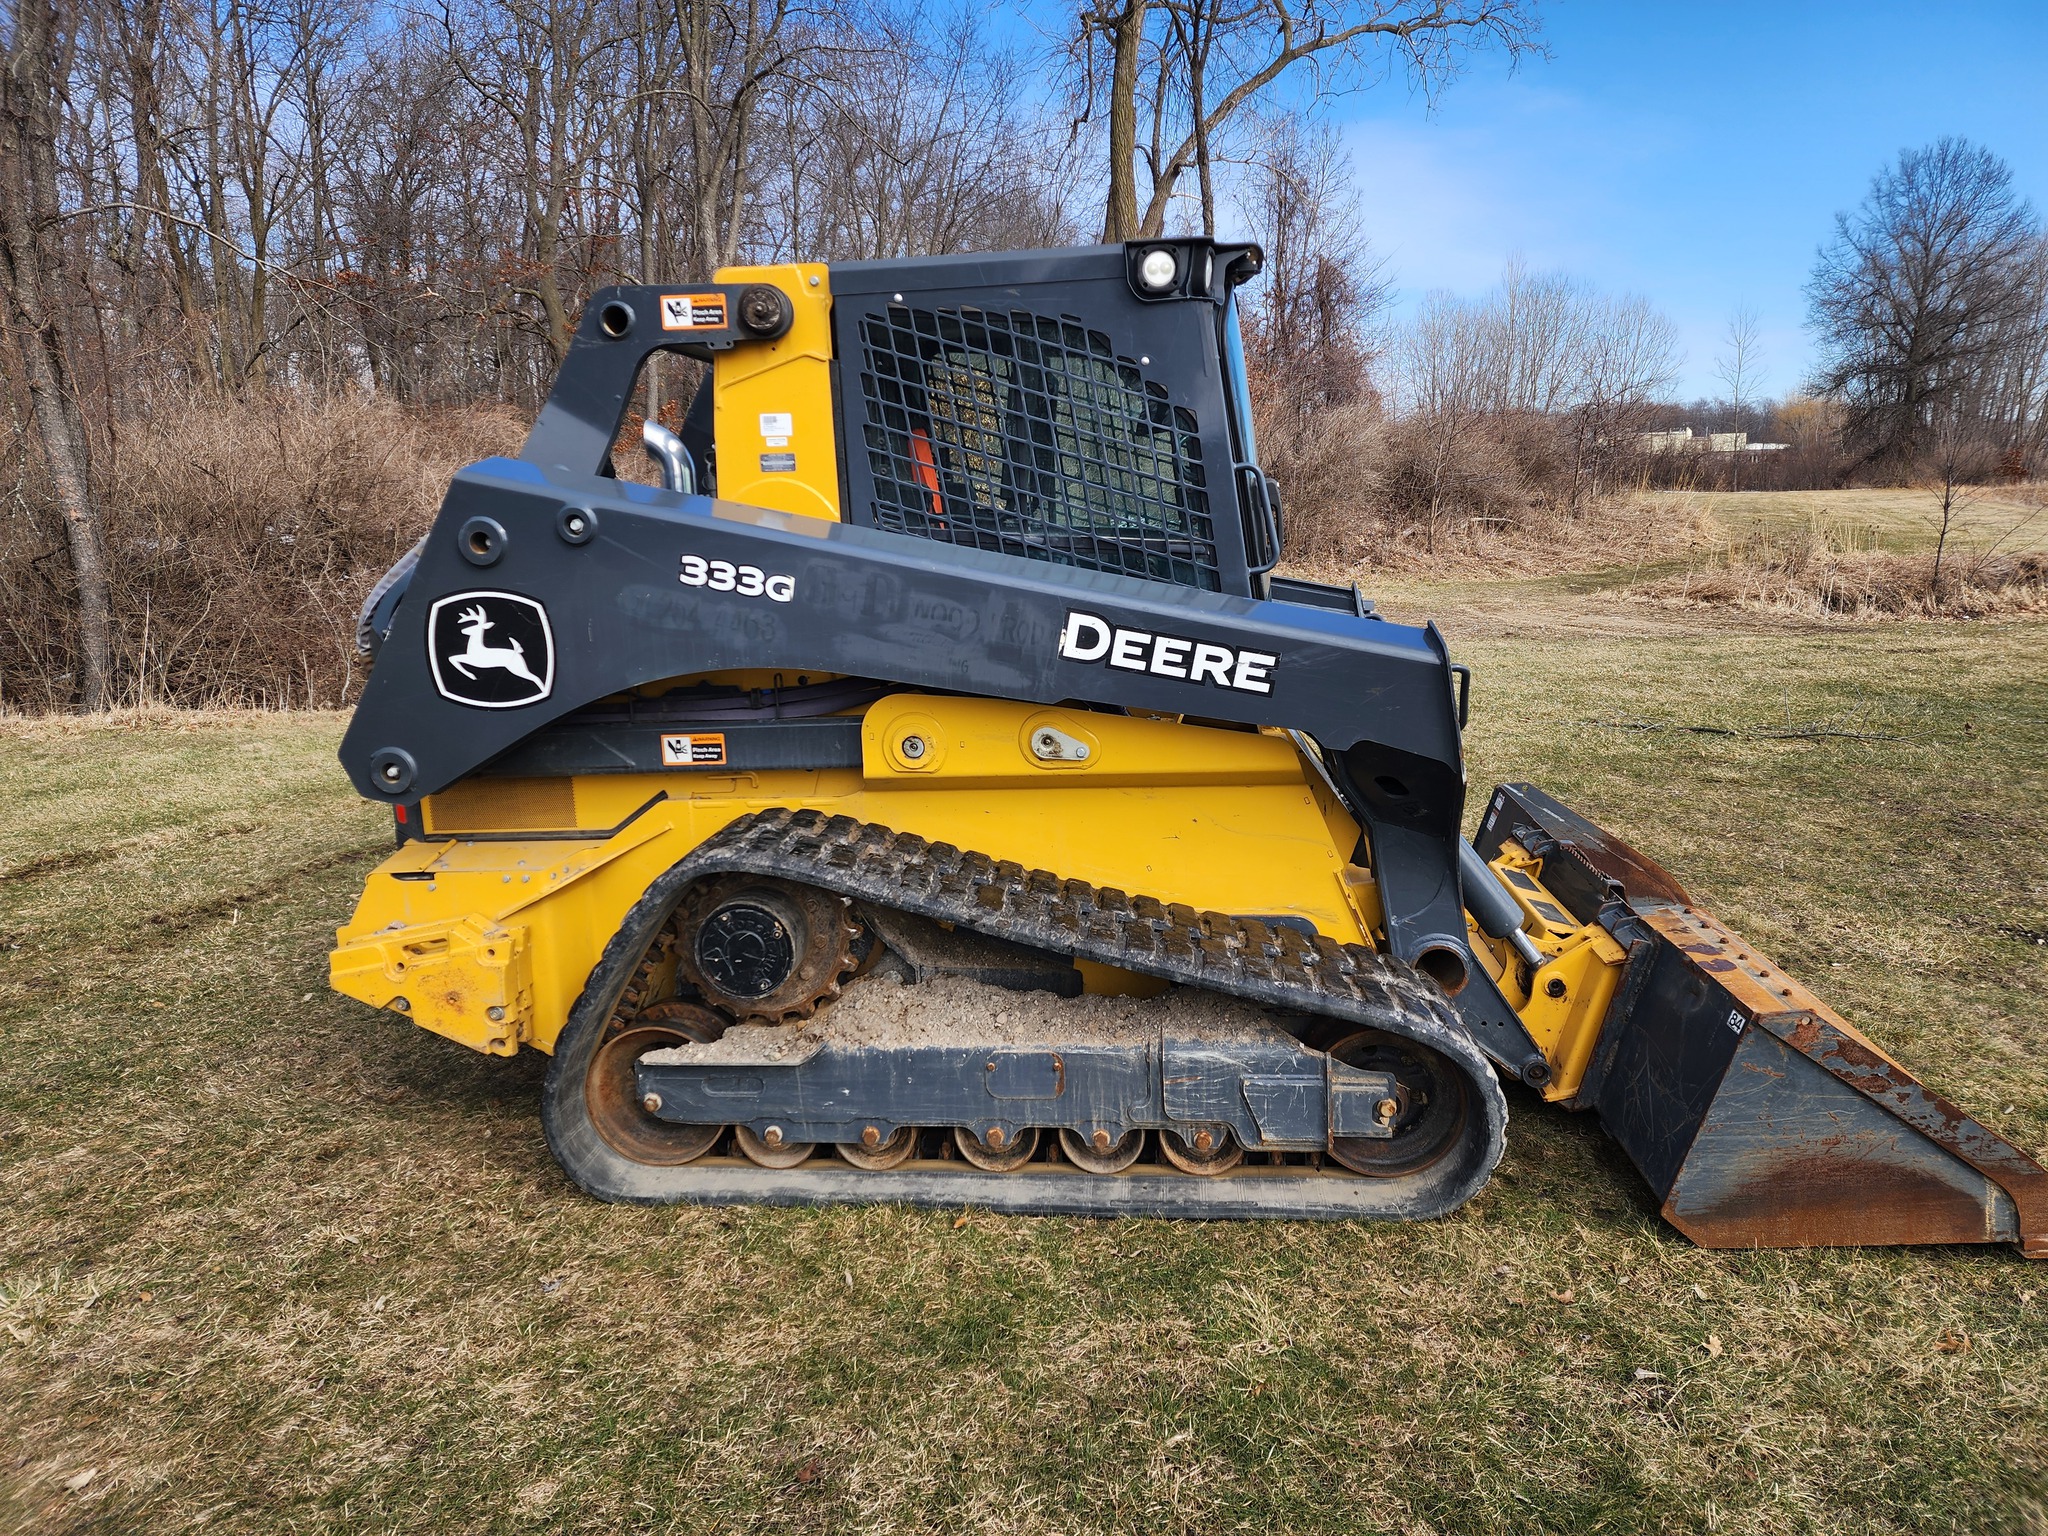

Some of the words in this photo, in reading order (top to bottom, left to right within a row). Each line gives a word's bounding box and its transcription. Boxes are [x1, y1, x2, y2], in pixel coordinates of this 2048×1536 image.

[680, 555, 795, 603] 333G
[1062, 610, 1275, 692] DEERE
[1729, 1013, 1743, 1030] 84
